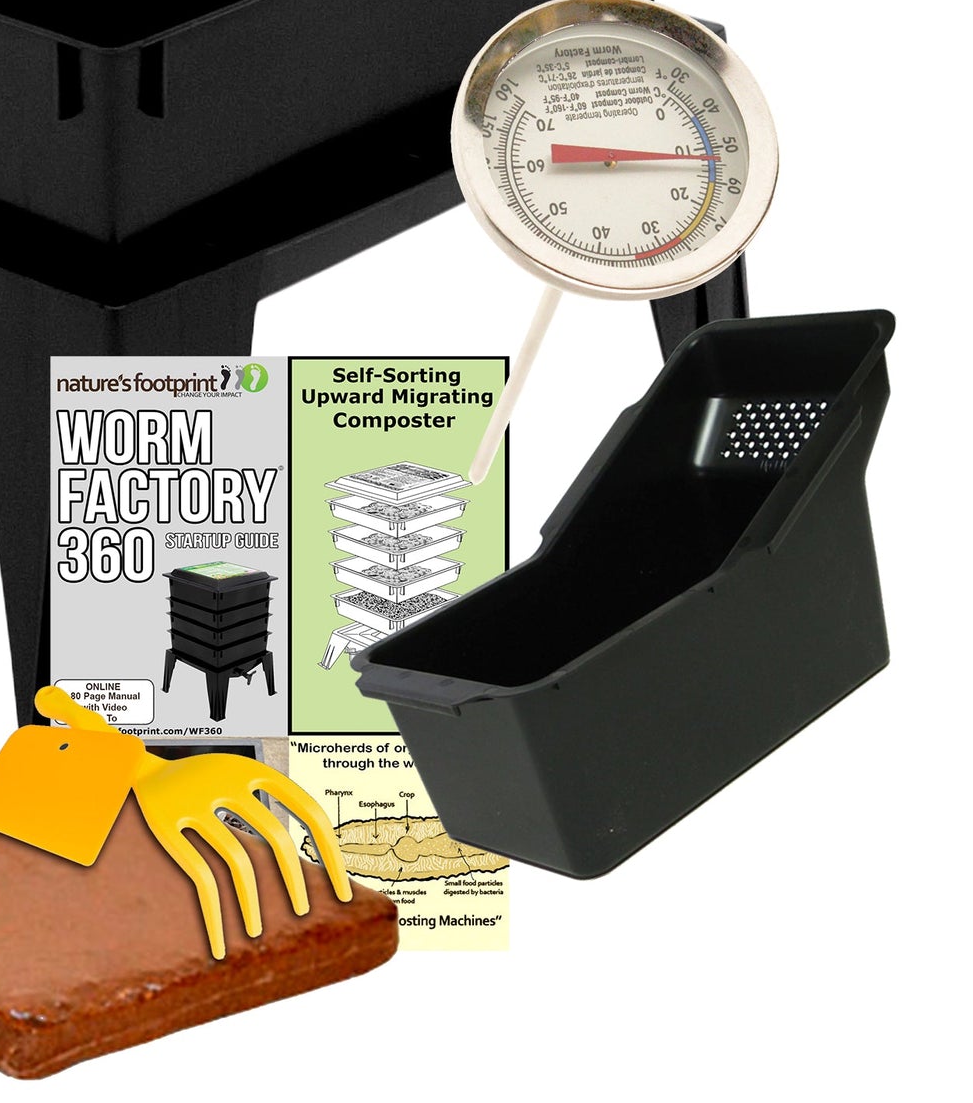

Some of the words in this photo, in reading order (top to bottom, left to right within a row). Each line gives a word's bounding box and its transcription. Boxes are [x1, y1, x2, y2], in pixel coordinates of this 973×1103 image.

[554, 48, 590, 58] Factory
[592, 45, 622, 55] Worm
[581, 70, 603, 78] jardin
[615, 66, 646, 75] Compost
[671, 67, 690, 84] 30
[597, 76, 645, 87] temperatures
[495, 78, 519, 101] 160
[595, 88, 627, 98] Compost
[628, 86, 651, 96] Worm
[591, 98, 624, 108] Compost
[625, 96, 653, 105] Outdoor
[703, 98, 720, 114] 40
[565, 111, 602, 121] temperate
[603, 107, 638, 119] Operating
[656, 108, 665, 121] 0
[536, 118, 555, 132] 70
[722, 136, 739, 153] 50
[527, 159, 545, 173] 60
[727, 177, 741, 195] 60
[670, 187, 689, 200] 20
[549, 202, 568, 216] 50
[592, 225, 610, 240] 40
[641, 220, 660, 235] 30
[332, 367, 461, 386] Self-Sorting
[57, 374, 132, 392] nature's
[134, 372, 217, 398] footprint
[301, 388, 384, 407] Upward
[392, 388, 493, 407] Migrating
[333, 412, 456, 432] Composter
[56, 409, 213, 465] WORM
[58, 468, 278, 524] FACTORY
[165, 532, 232, 549] STARTUP
[234, 532, 279, 549] GUIDE
[57, 527, 155, 583] 360
[85, 682, 121, 691] ONLINE
[83, 692, 106, 702] Page
[108, 692, 141, 700] Manual
[102, 703, 128, 712] Video
[106, 713, 118, 723] To
[376, 742, 390, 753] of
[394, 744, 409, 753] or
[323, 758, 375, 771] through
[378, 758, 400, 768] the
[325, 789, 353, 798] Pharynx
[399, 791, 415, 799] Crop
[358, 801, 395, 809] Esophagus
[477, 880, 503, 888] particles
[398, 915, 436, 929] osting
